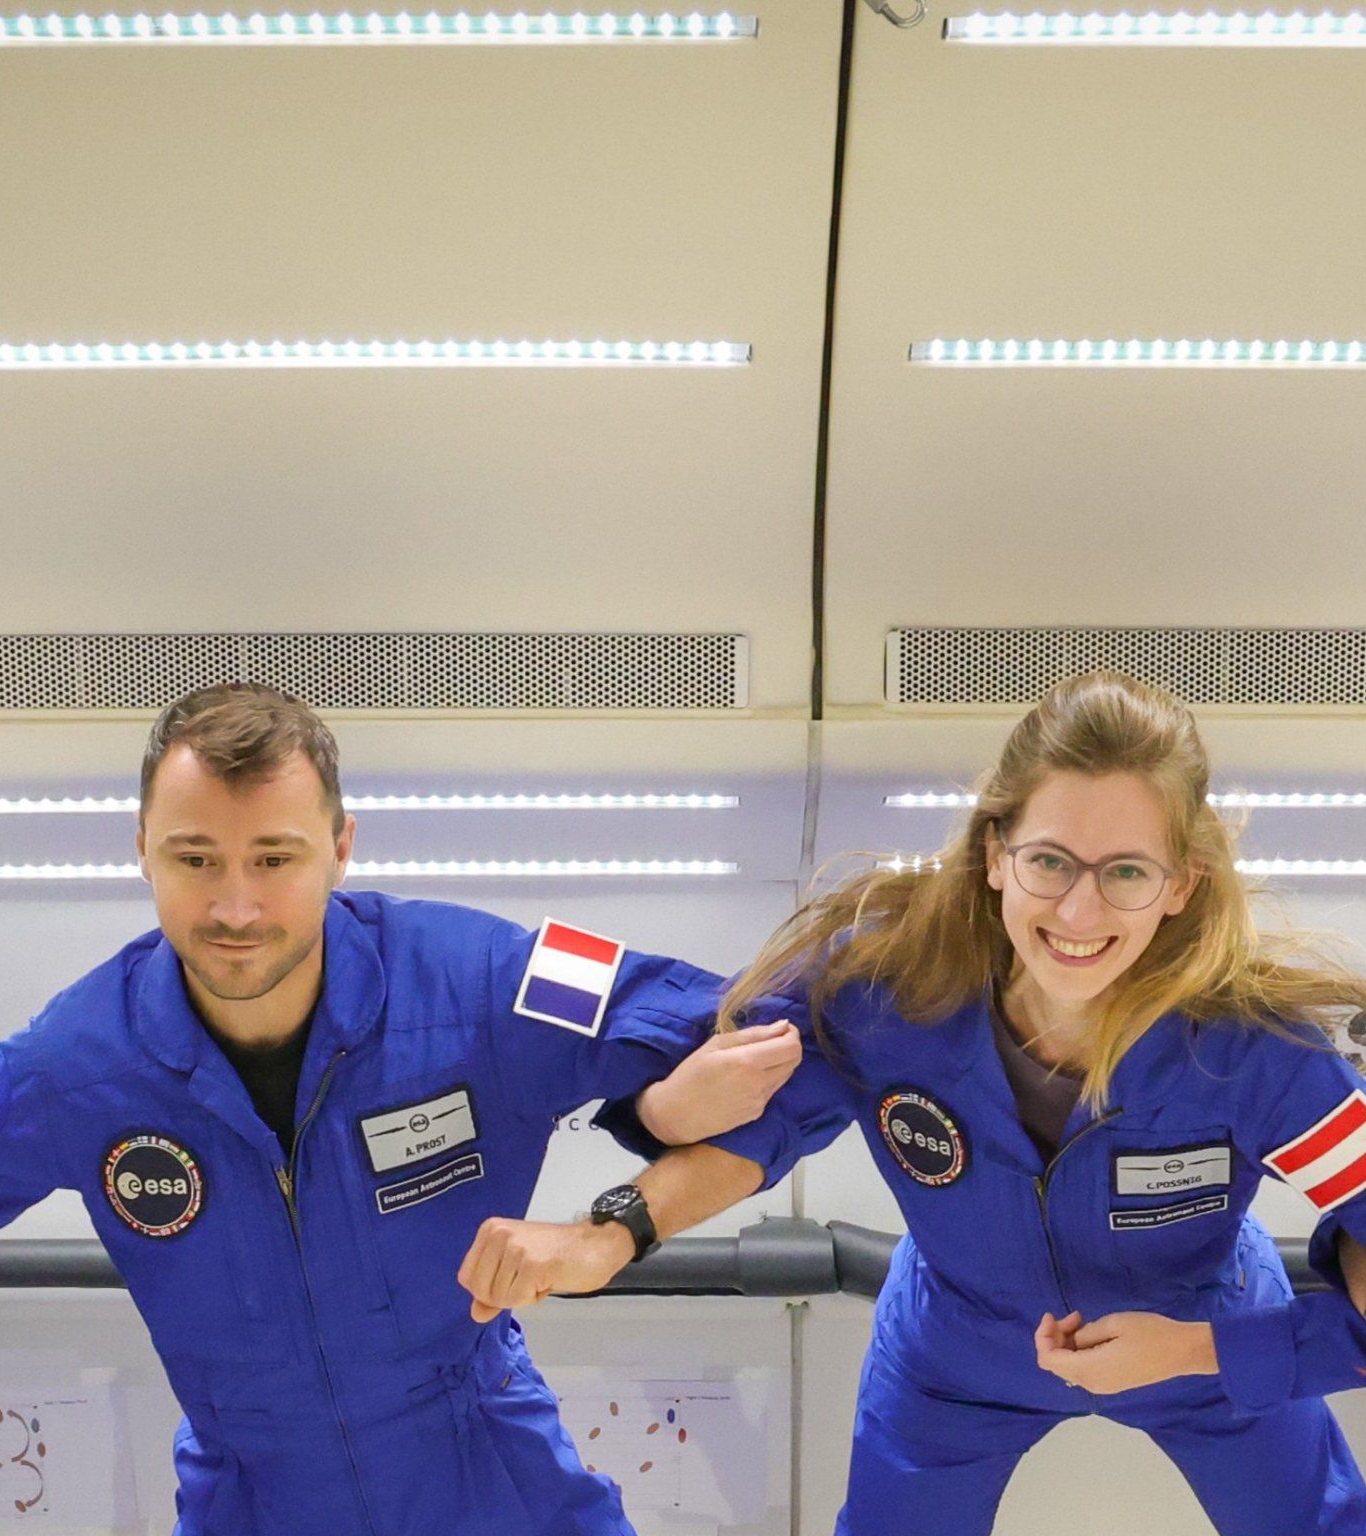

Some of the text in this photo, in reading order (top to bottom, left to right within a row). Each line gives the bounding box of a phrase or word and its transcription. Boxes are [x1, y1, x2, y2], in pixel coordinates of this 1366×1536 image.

[416, 1134, 446, 1154] PROST
[914, 1132, 951, 1156] esa
[144, 1178, 187, 1195] esa
[1156, 1175, 1202, 1189] POSSNIG
[383, 1188, 419, 1204] European
